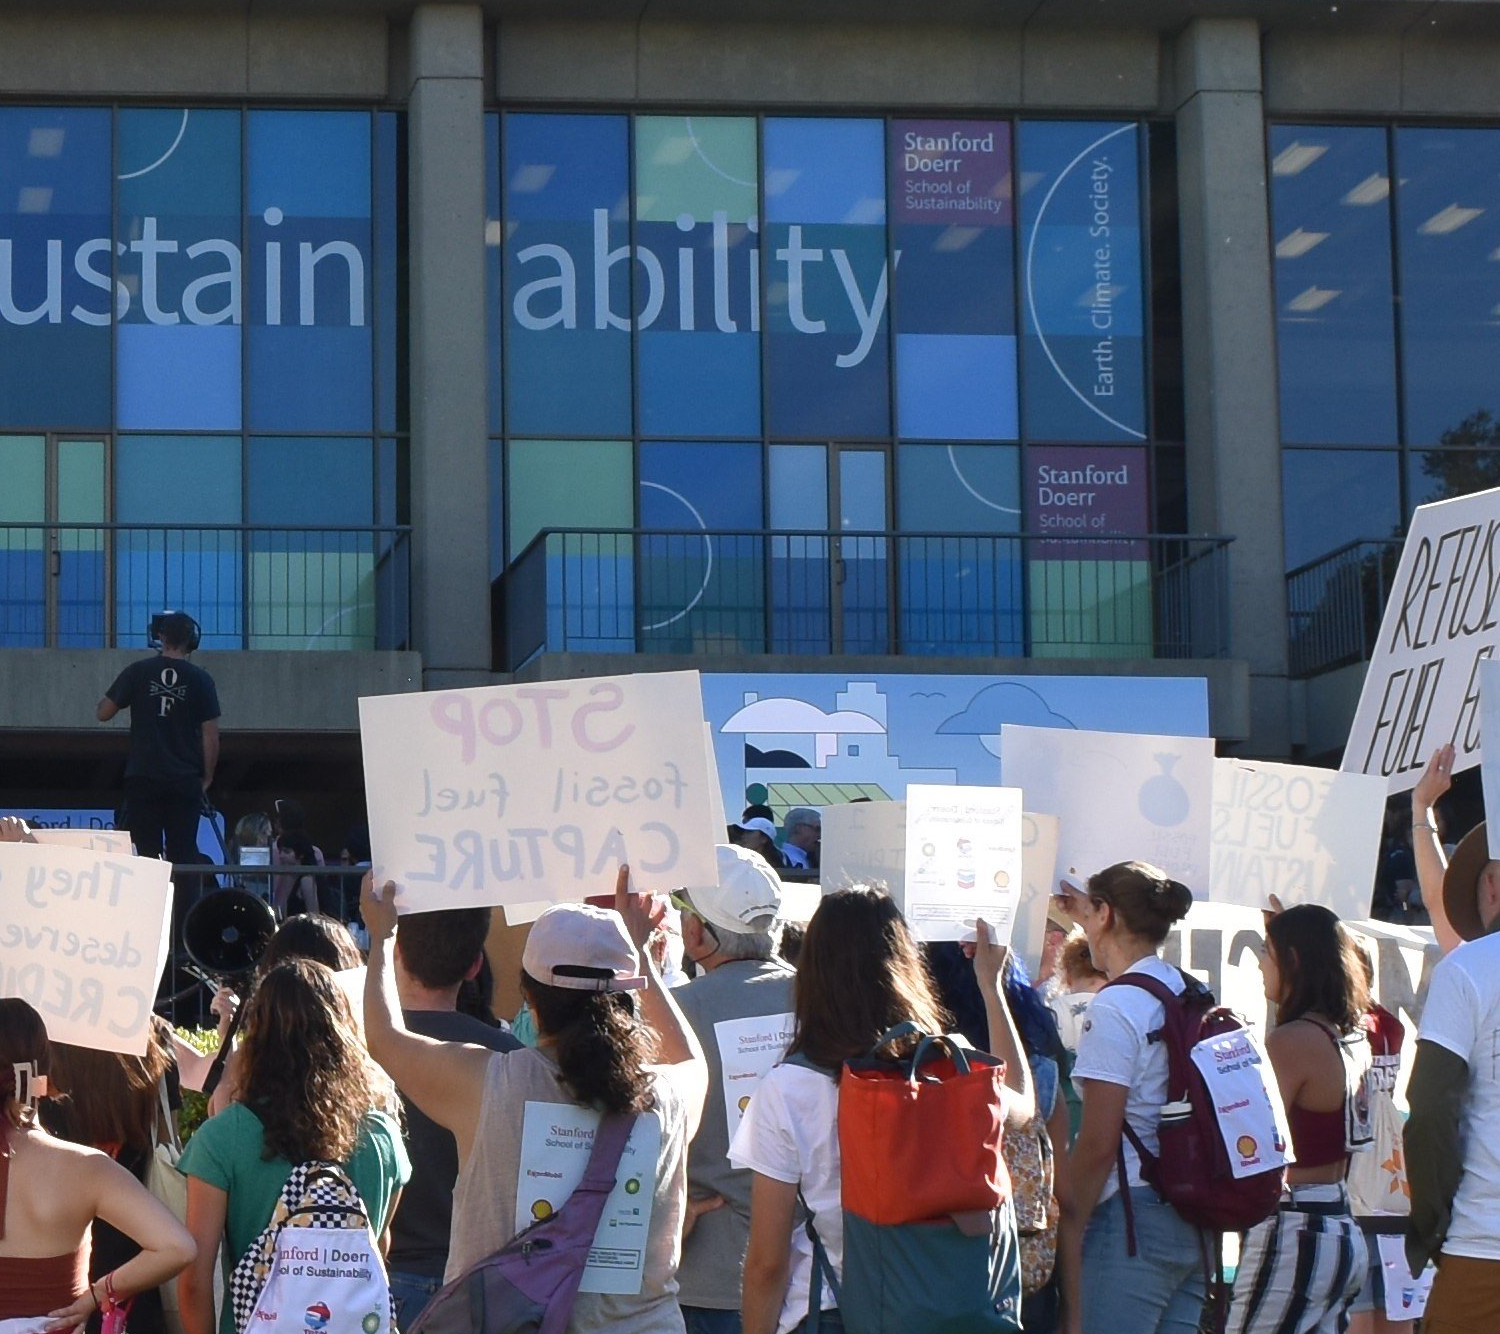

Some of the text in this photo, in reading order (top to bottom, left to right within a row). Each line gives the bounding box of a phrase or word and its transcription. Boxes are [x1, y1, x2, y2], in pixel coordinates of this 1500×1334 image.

[904, 132, 994, 152] Stanford
[904, 153, 962, 172] Doerr
[905, 180, 972, 193] School of
[905, 196, 1002, 213] Sustainability
[1089, 156, 1114, 397] Earth. Climate. Society.
[511, 208, 902, 368] ability
[1038, 464, 1128, 484] Stanford
[1039, 487, 1096, 506] Doerr
[1040, 513, 1106, 527] School of
[1362, 657, 1445, 777] FUEL
[550, 1125, 594, 1139] Stanford
[545, 1138, 573, 1148] School
[279, 1246, 370, 1263] nford Doerr
